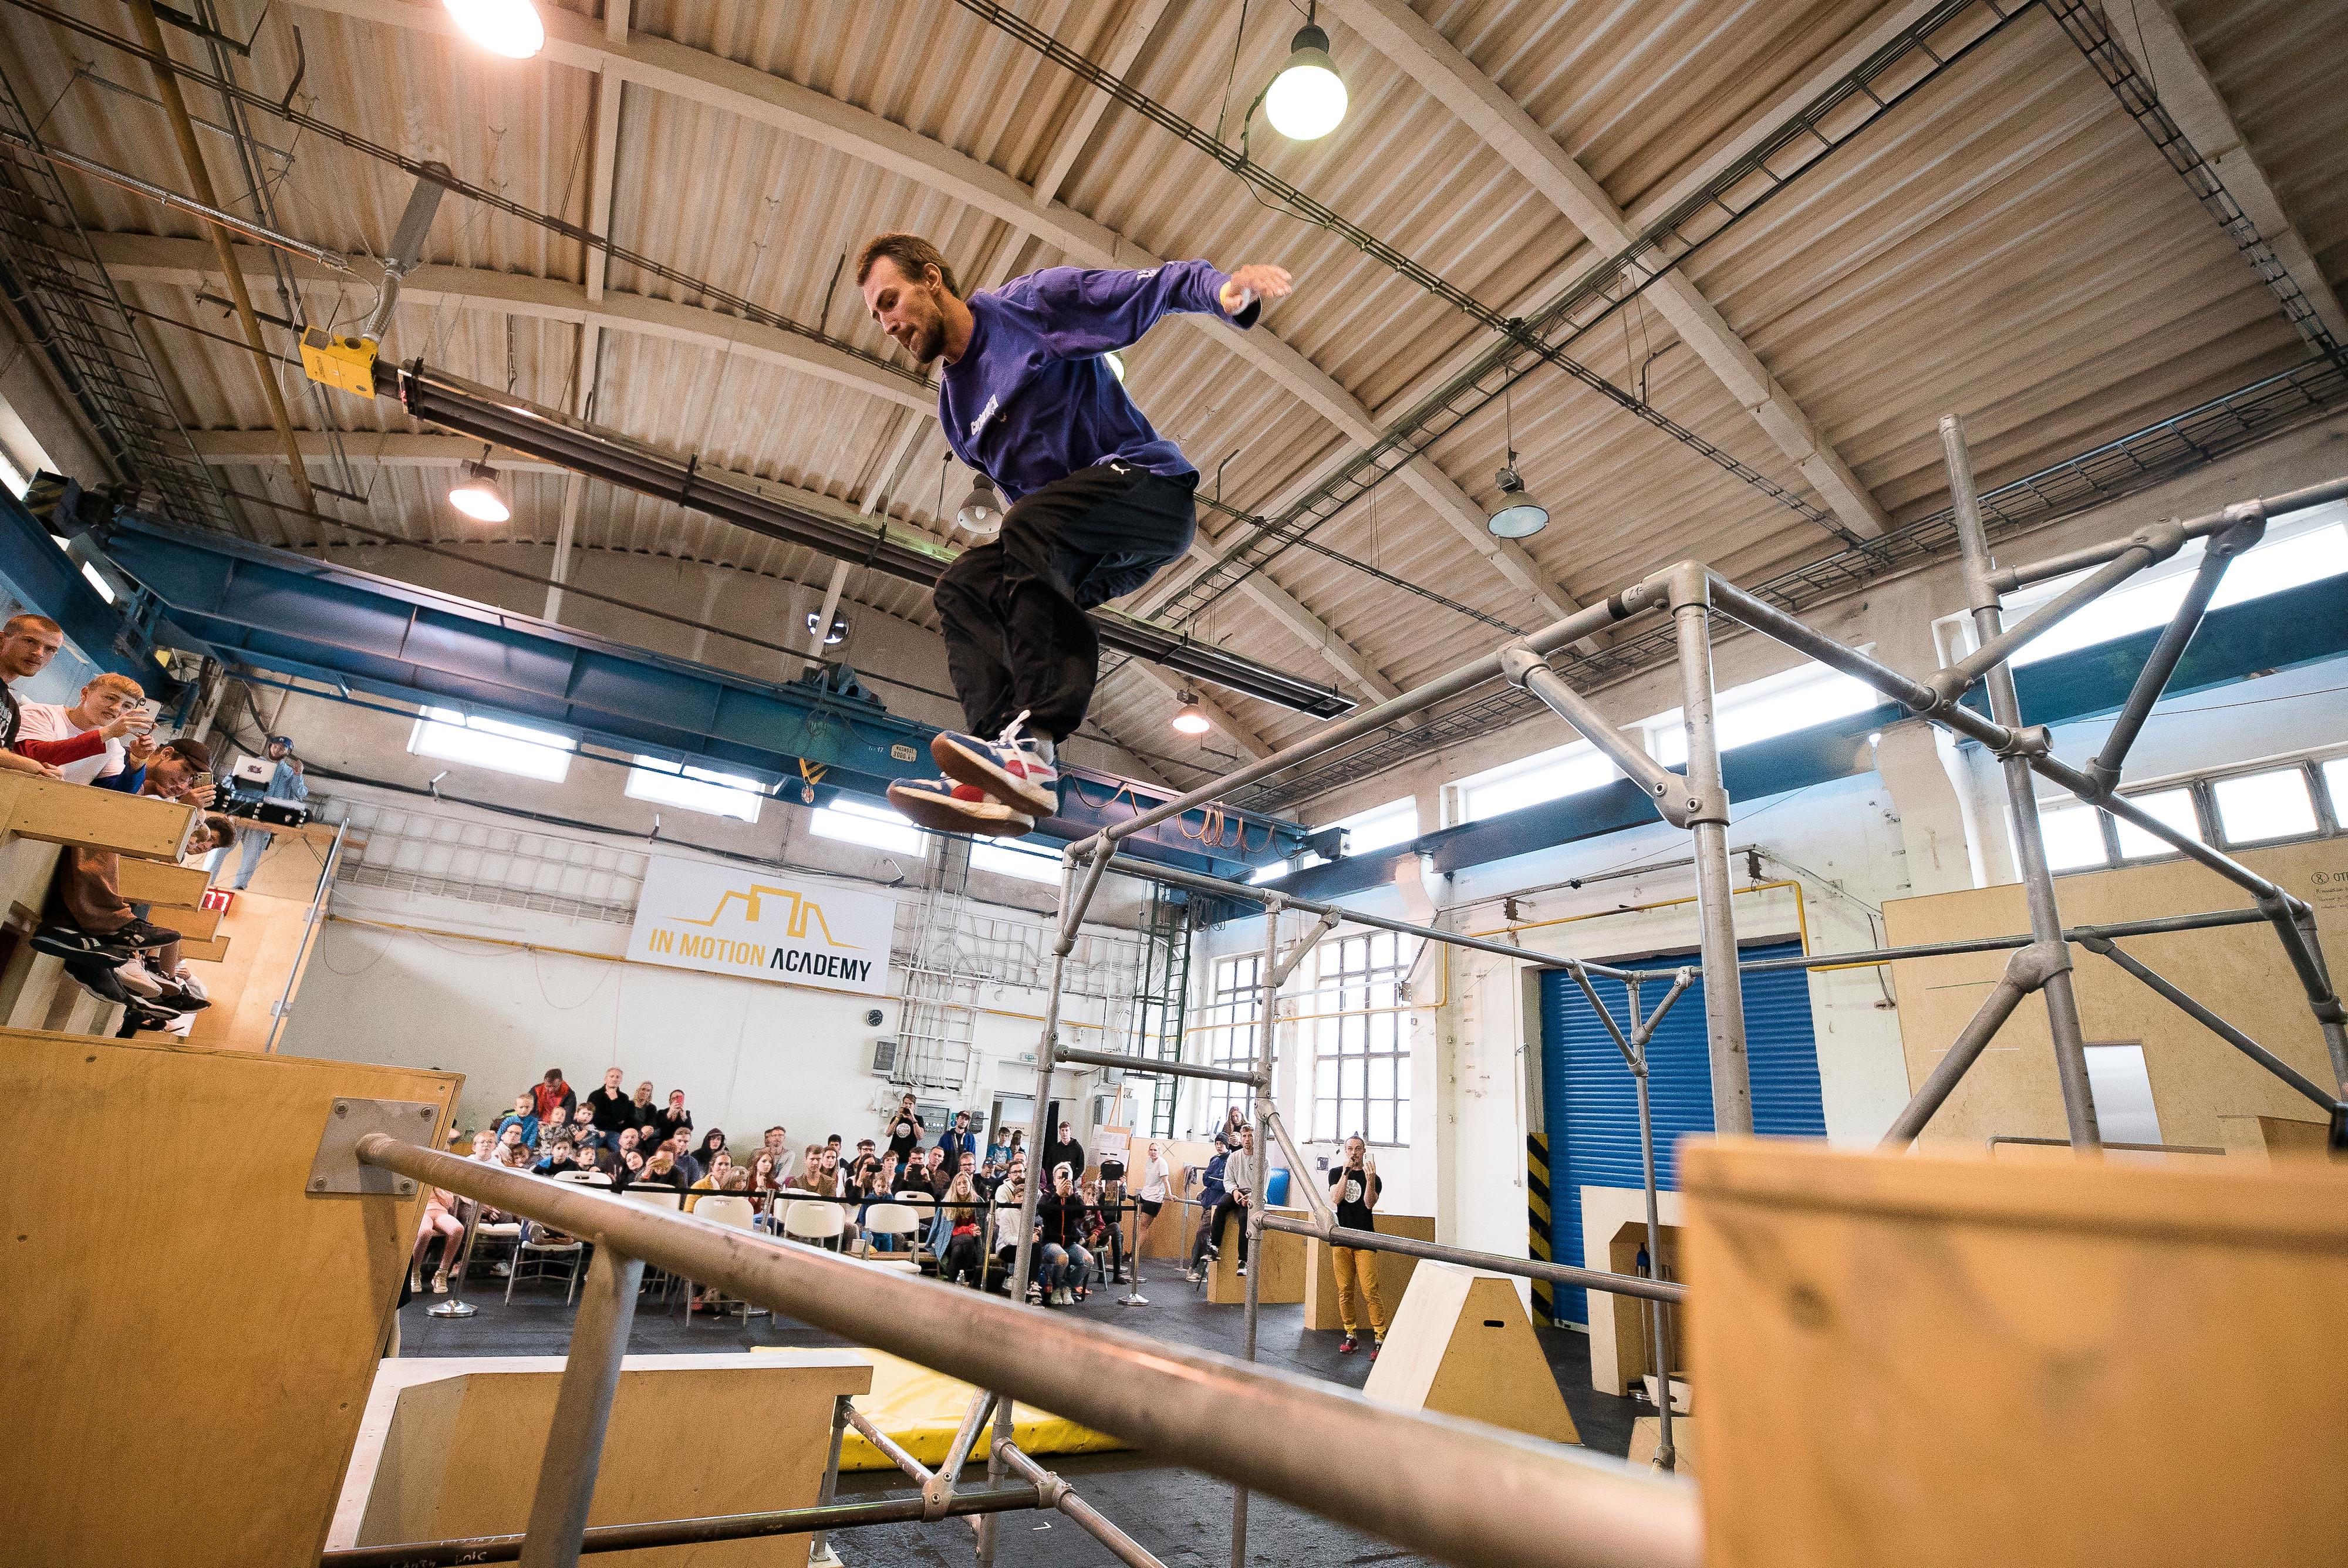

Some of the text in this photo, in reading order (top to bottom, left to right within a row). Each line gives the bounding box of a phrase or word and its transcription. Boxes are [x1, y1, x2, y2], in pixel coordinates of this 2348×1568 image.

[893, 751, 906, 759] 3000
[649, 928, 872, 982] IN MOTION ACADEMY
